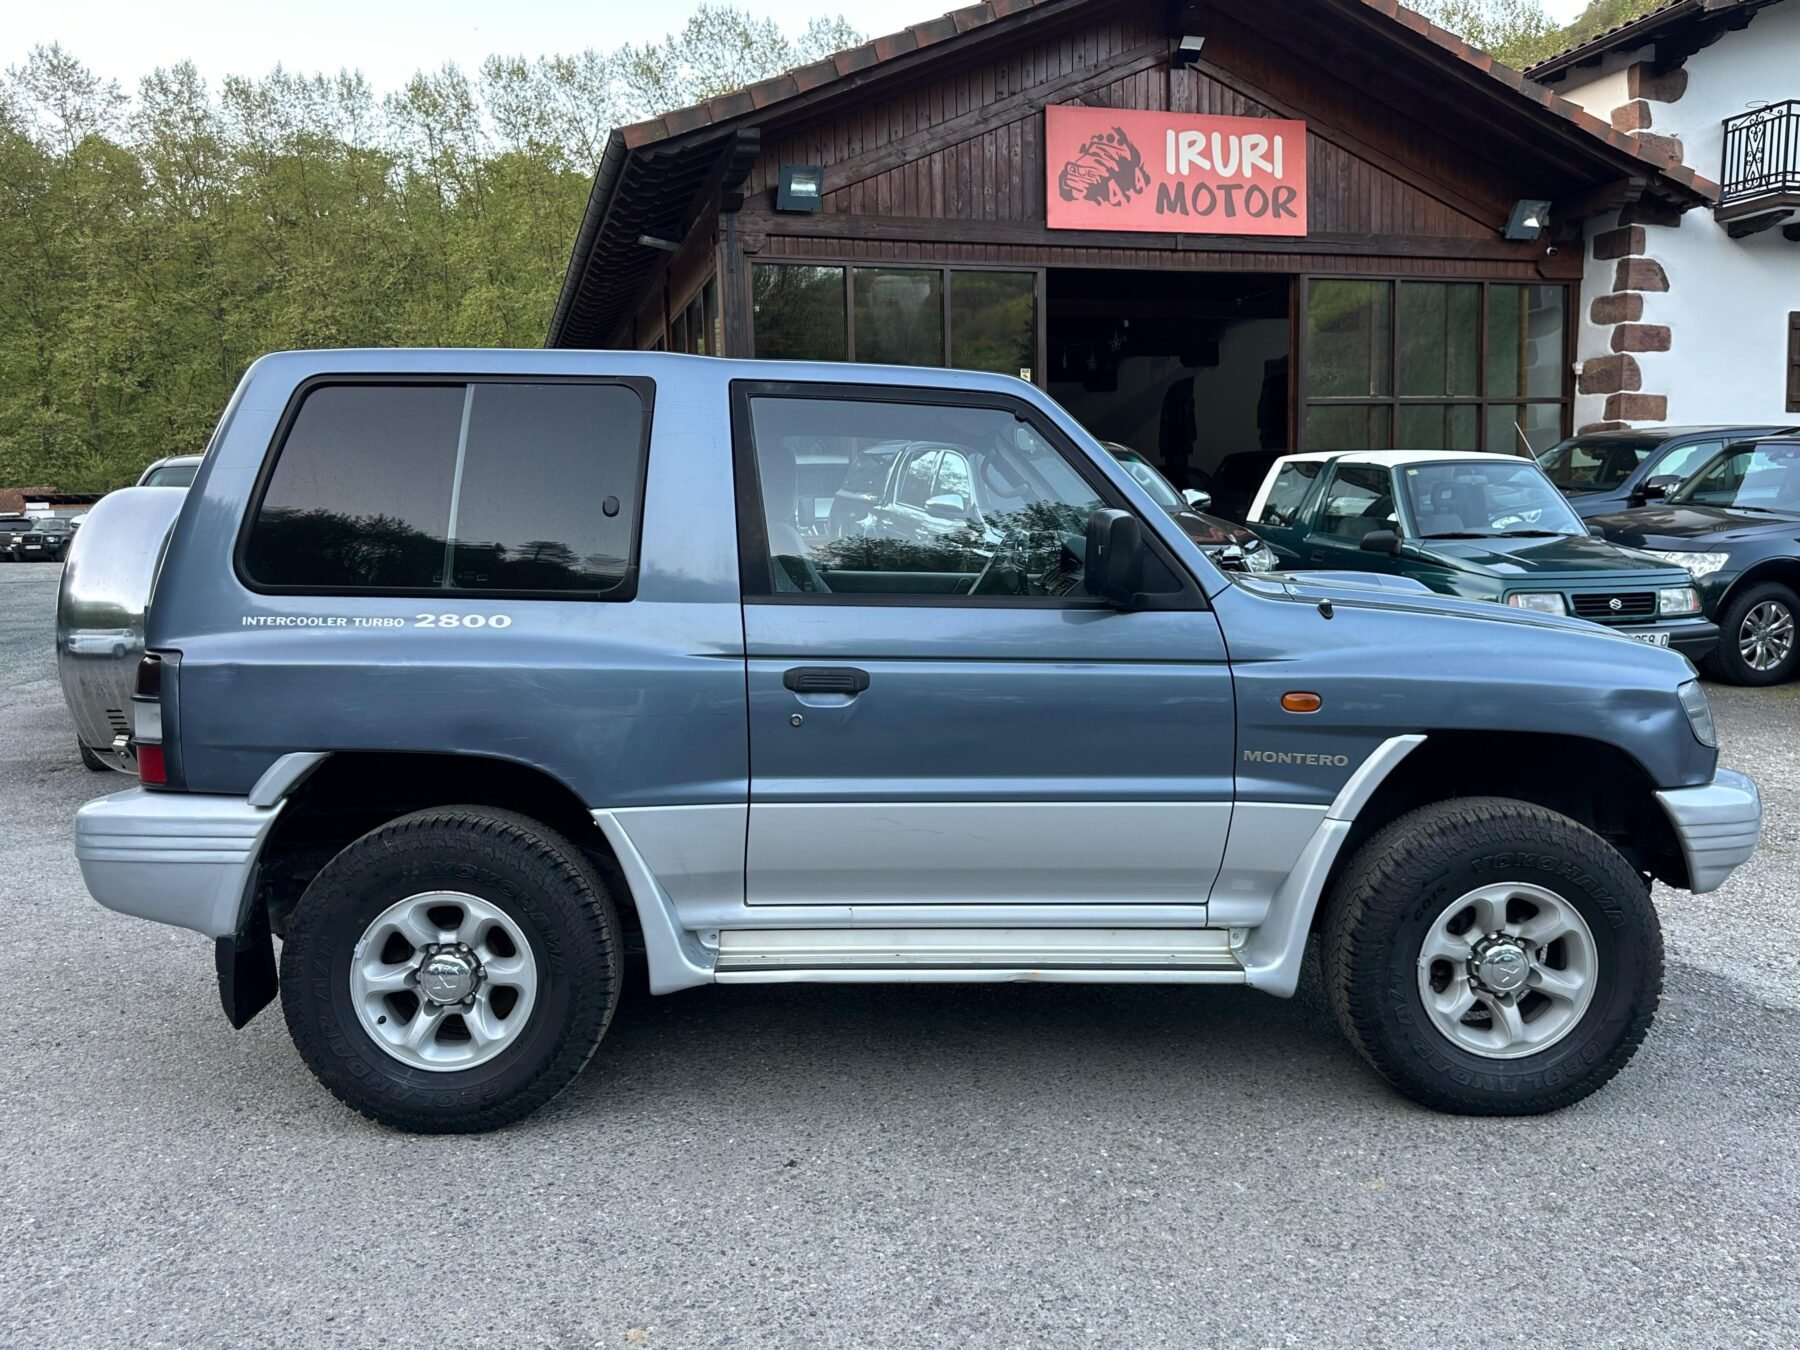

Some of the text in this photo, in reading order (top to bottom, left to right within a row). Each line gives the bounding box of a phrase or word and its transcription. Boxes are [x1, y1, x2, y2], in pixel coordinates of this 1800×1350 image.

[1166, 128, 1283, 180] IRURI
[1155, 181, 1298, 219] MOTOR
[242, 613, 513, 629] INTERCOOLER TURBO 2800
[1243, 750, 1349, 767] MONTERO
[1471, 851, 1625, 930] YOKOHAMA
